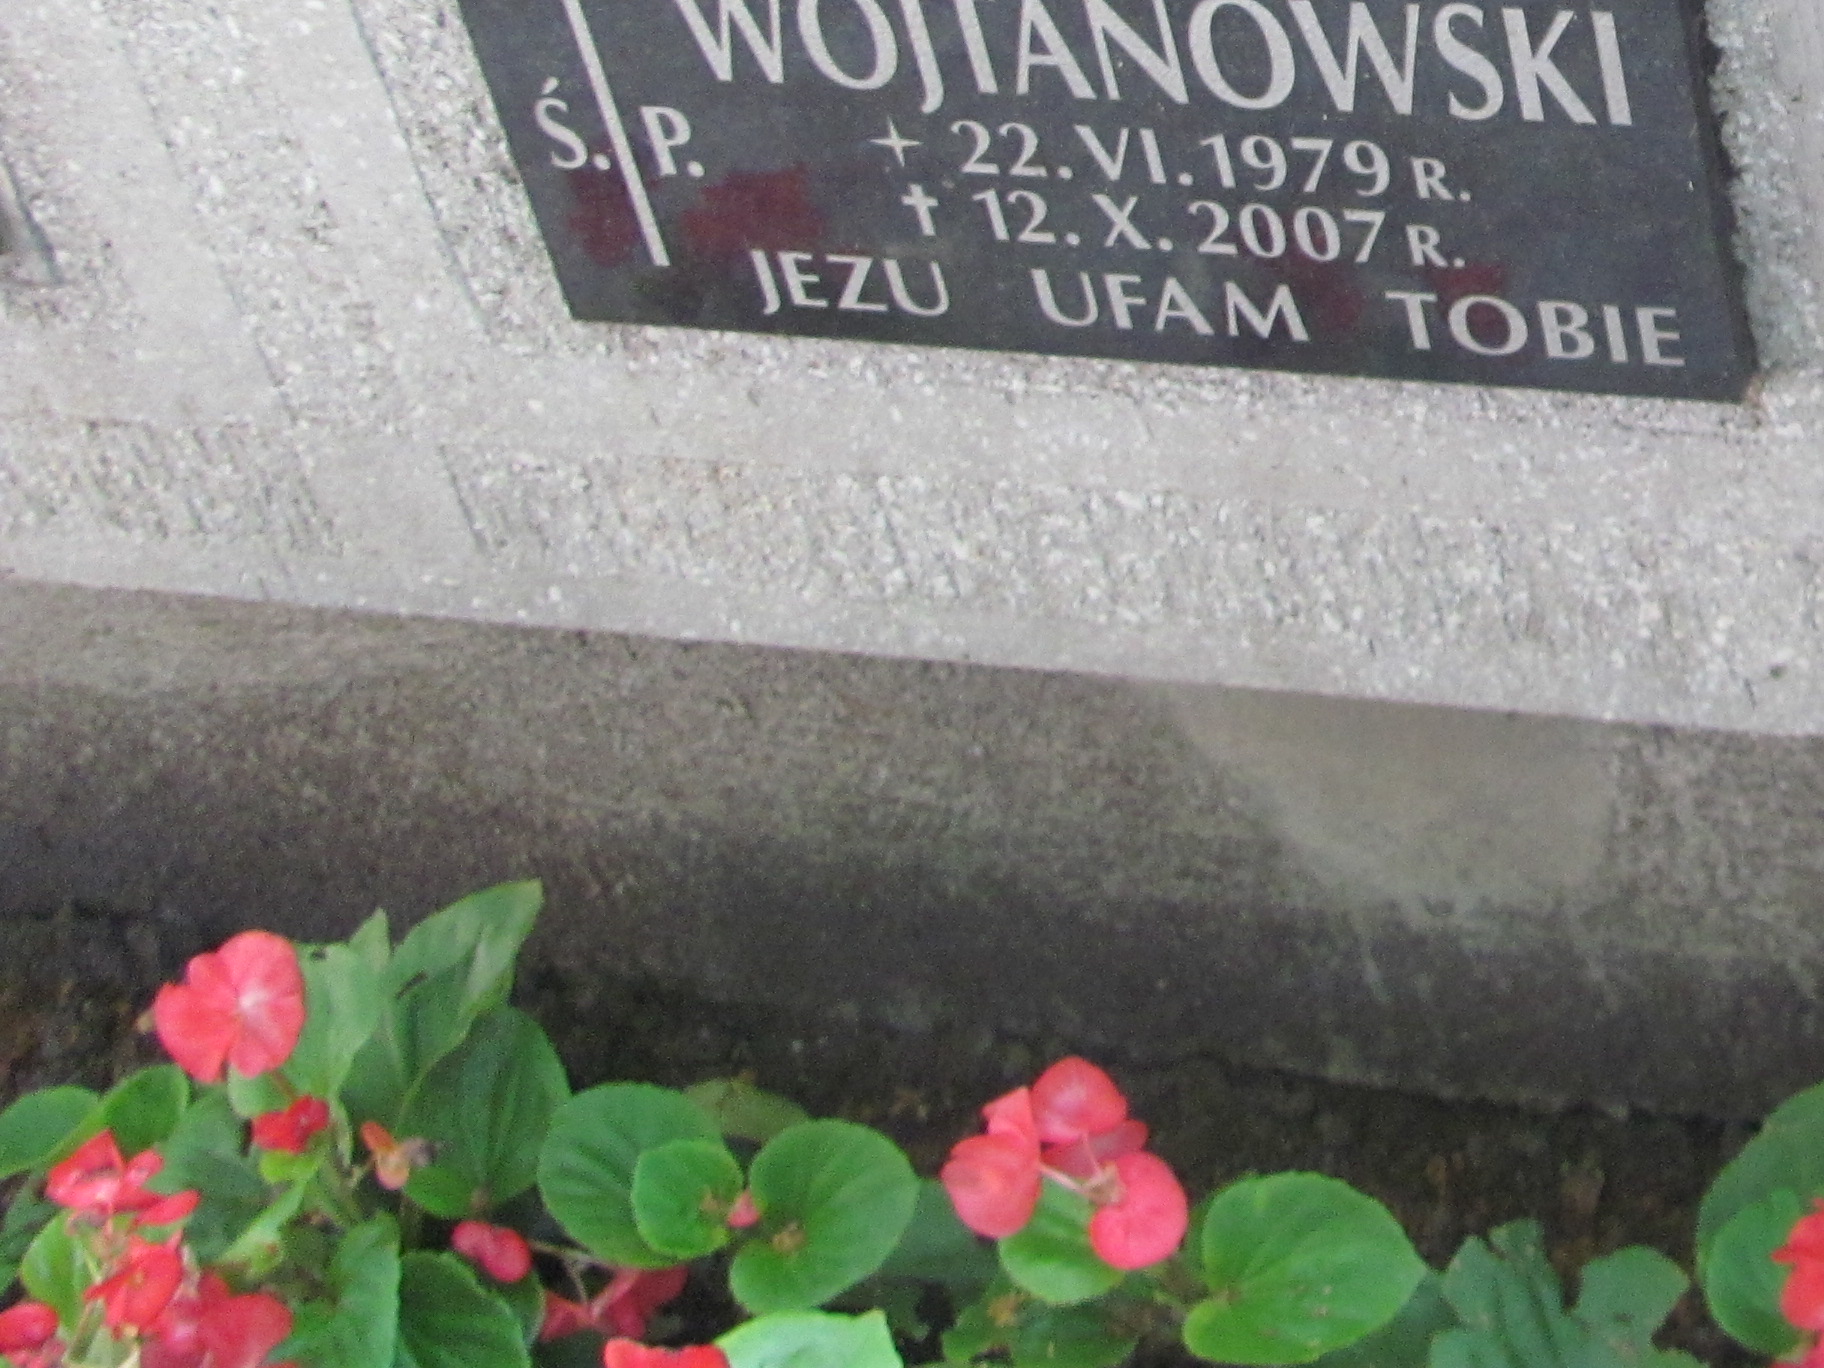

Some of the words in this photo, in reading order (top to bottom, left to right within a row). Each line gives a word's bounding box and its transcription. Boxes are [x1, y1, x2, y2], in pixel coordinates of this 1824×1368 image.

[950, 120, 1391, 198] 22.VI.1979
[1410, 156, 1472, 202] R.
[1405, 223, 1466, 268] R.
[751, 248, 951, 316] JEZU
[1030, 267, 1310, 343] UFAM
[1385, 290, 1685, 367] TOBIE
